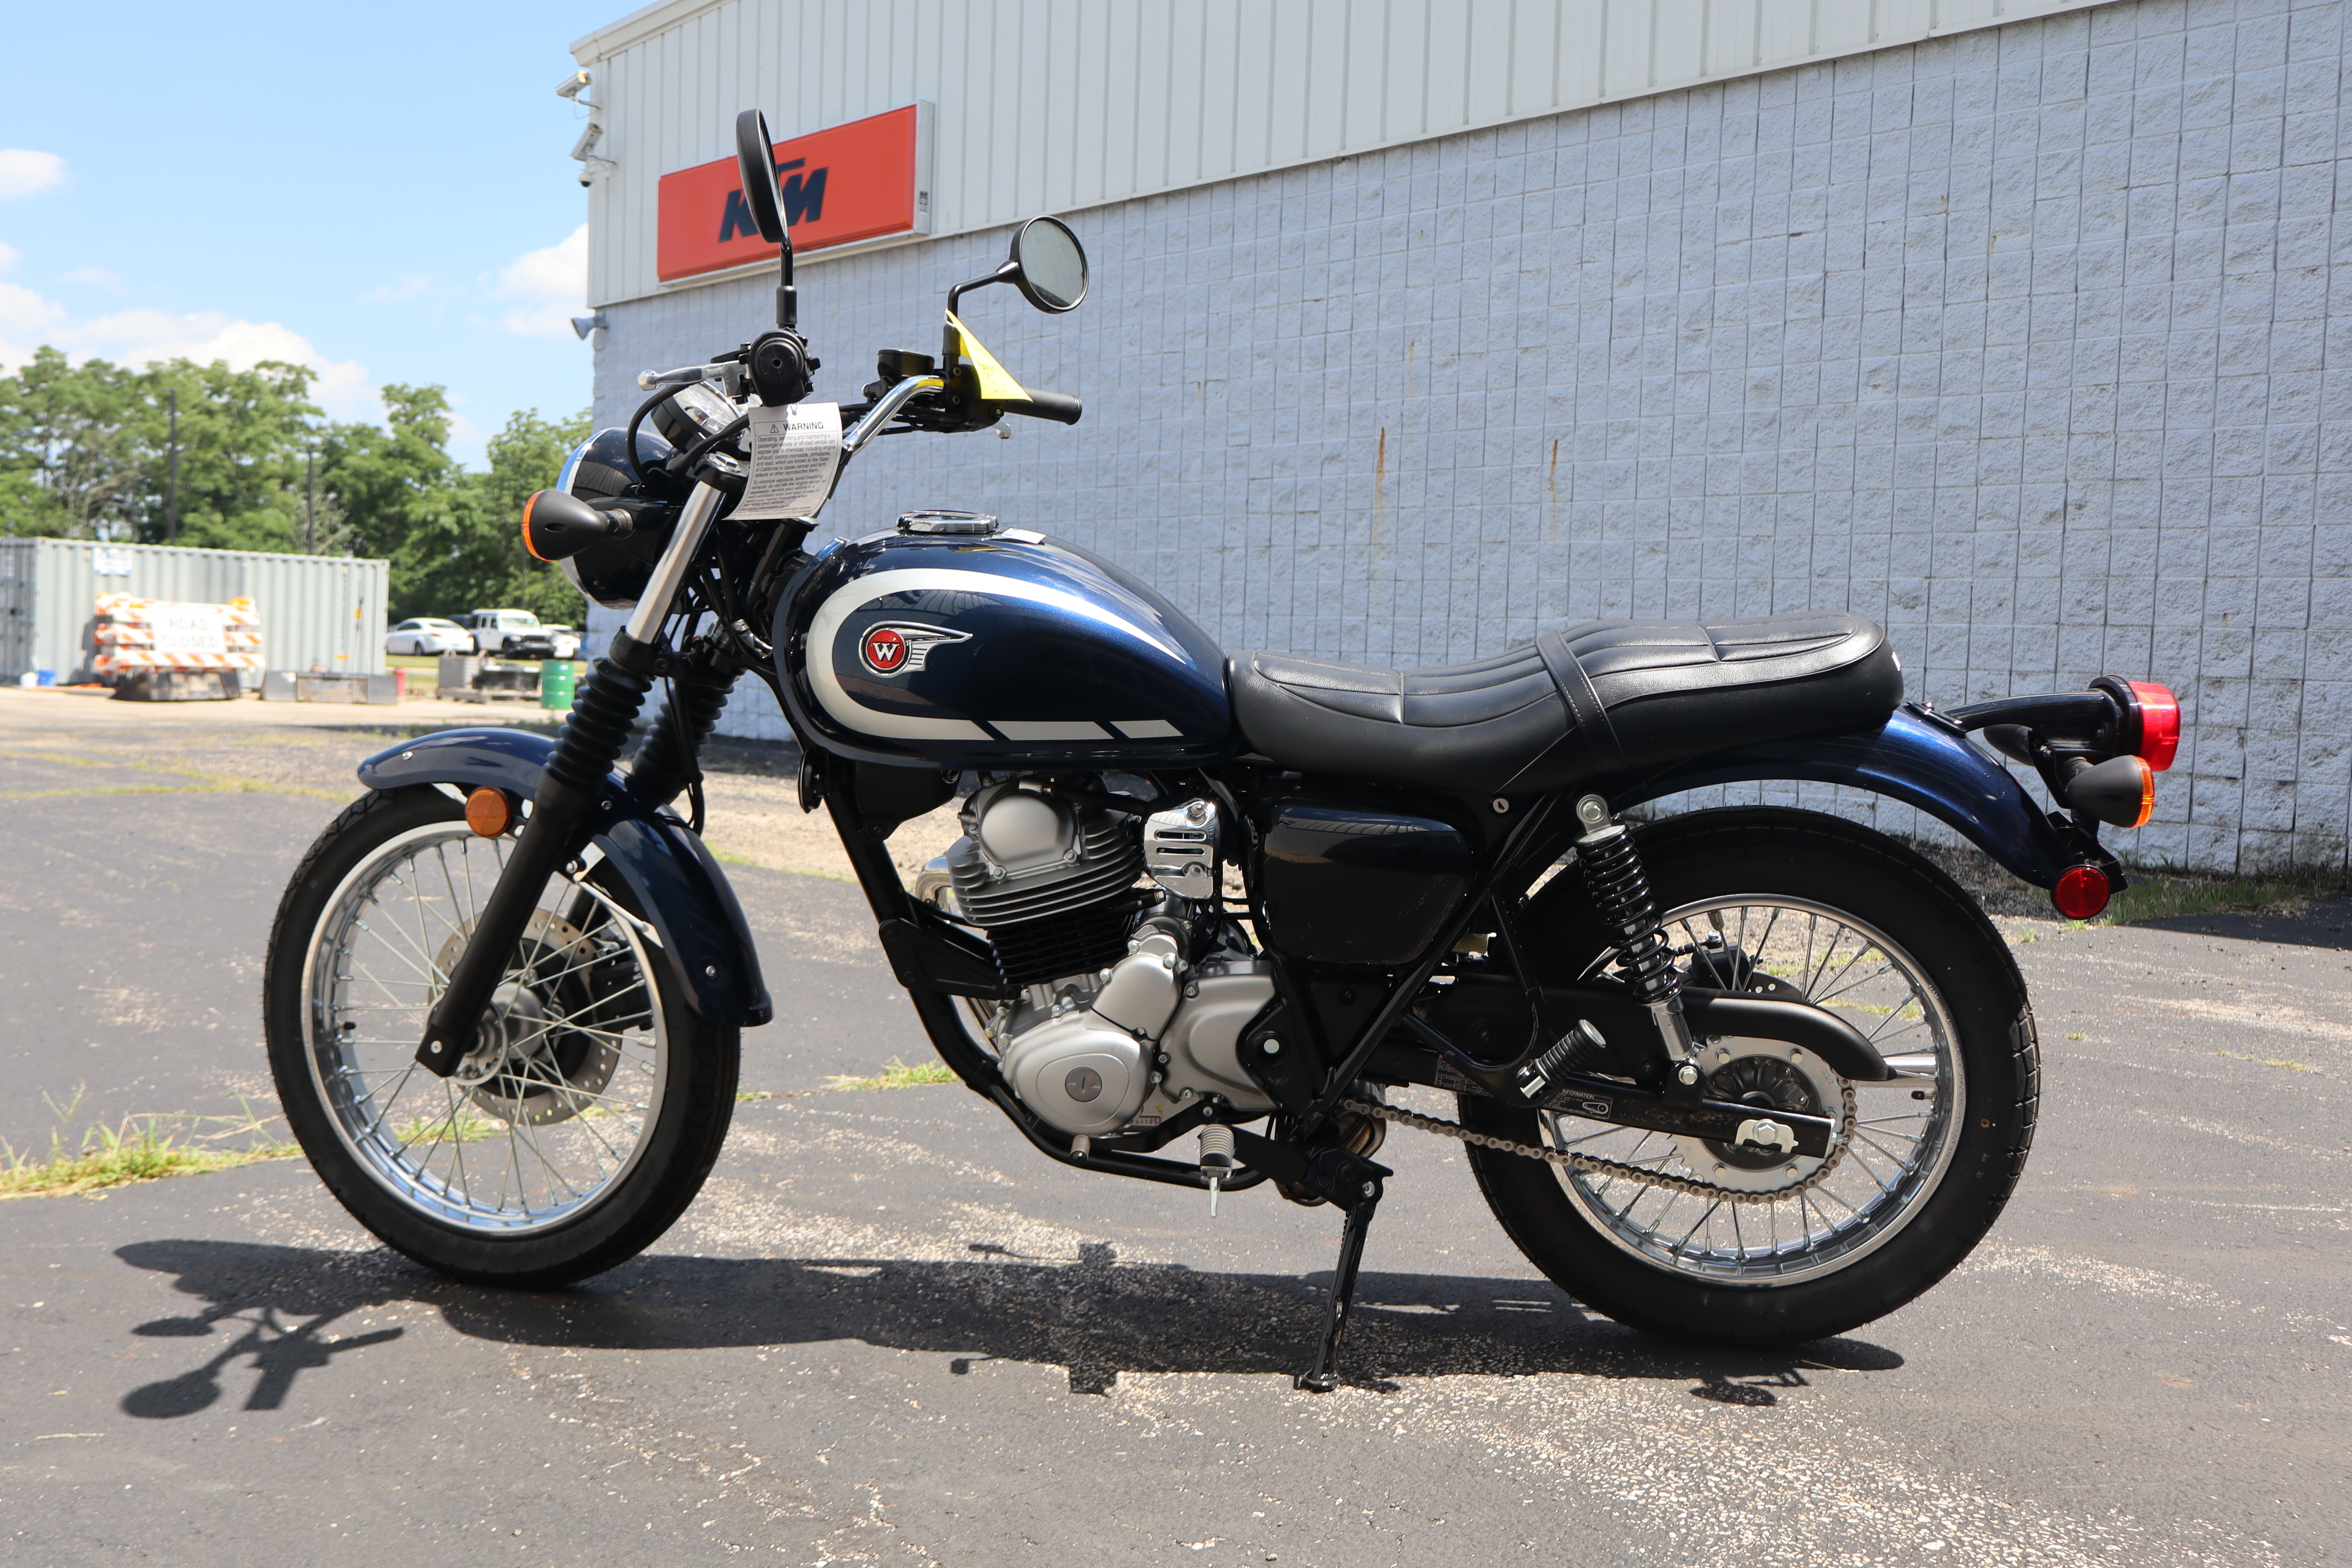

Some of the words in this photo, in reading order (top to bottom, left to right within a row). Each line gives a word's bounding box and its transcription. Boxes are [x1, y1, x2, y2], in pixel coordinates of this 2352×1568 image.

[783, 421, 824, 431] WARNING
[167, 617, 209, 631] ROAD
[160, 634, 218, 648] CLOSED
[872, 642, 900, 662] W
[1946, 1019, 1957, 1041] UNION
[1562, 1089, 1595, 1099] INFORMATION
